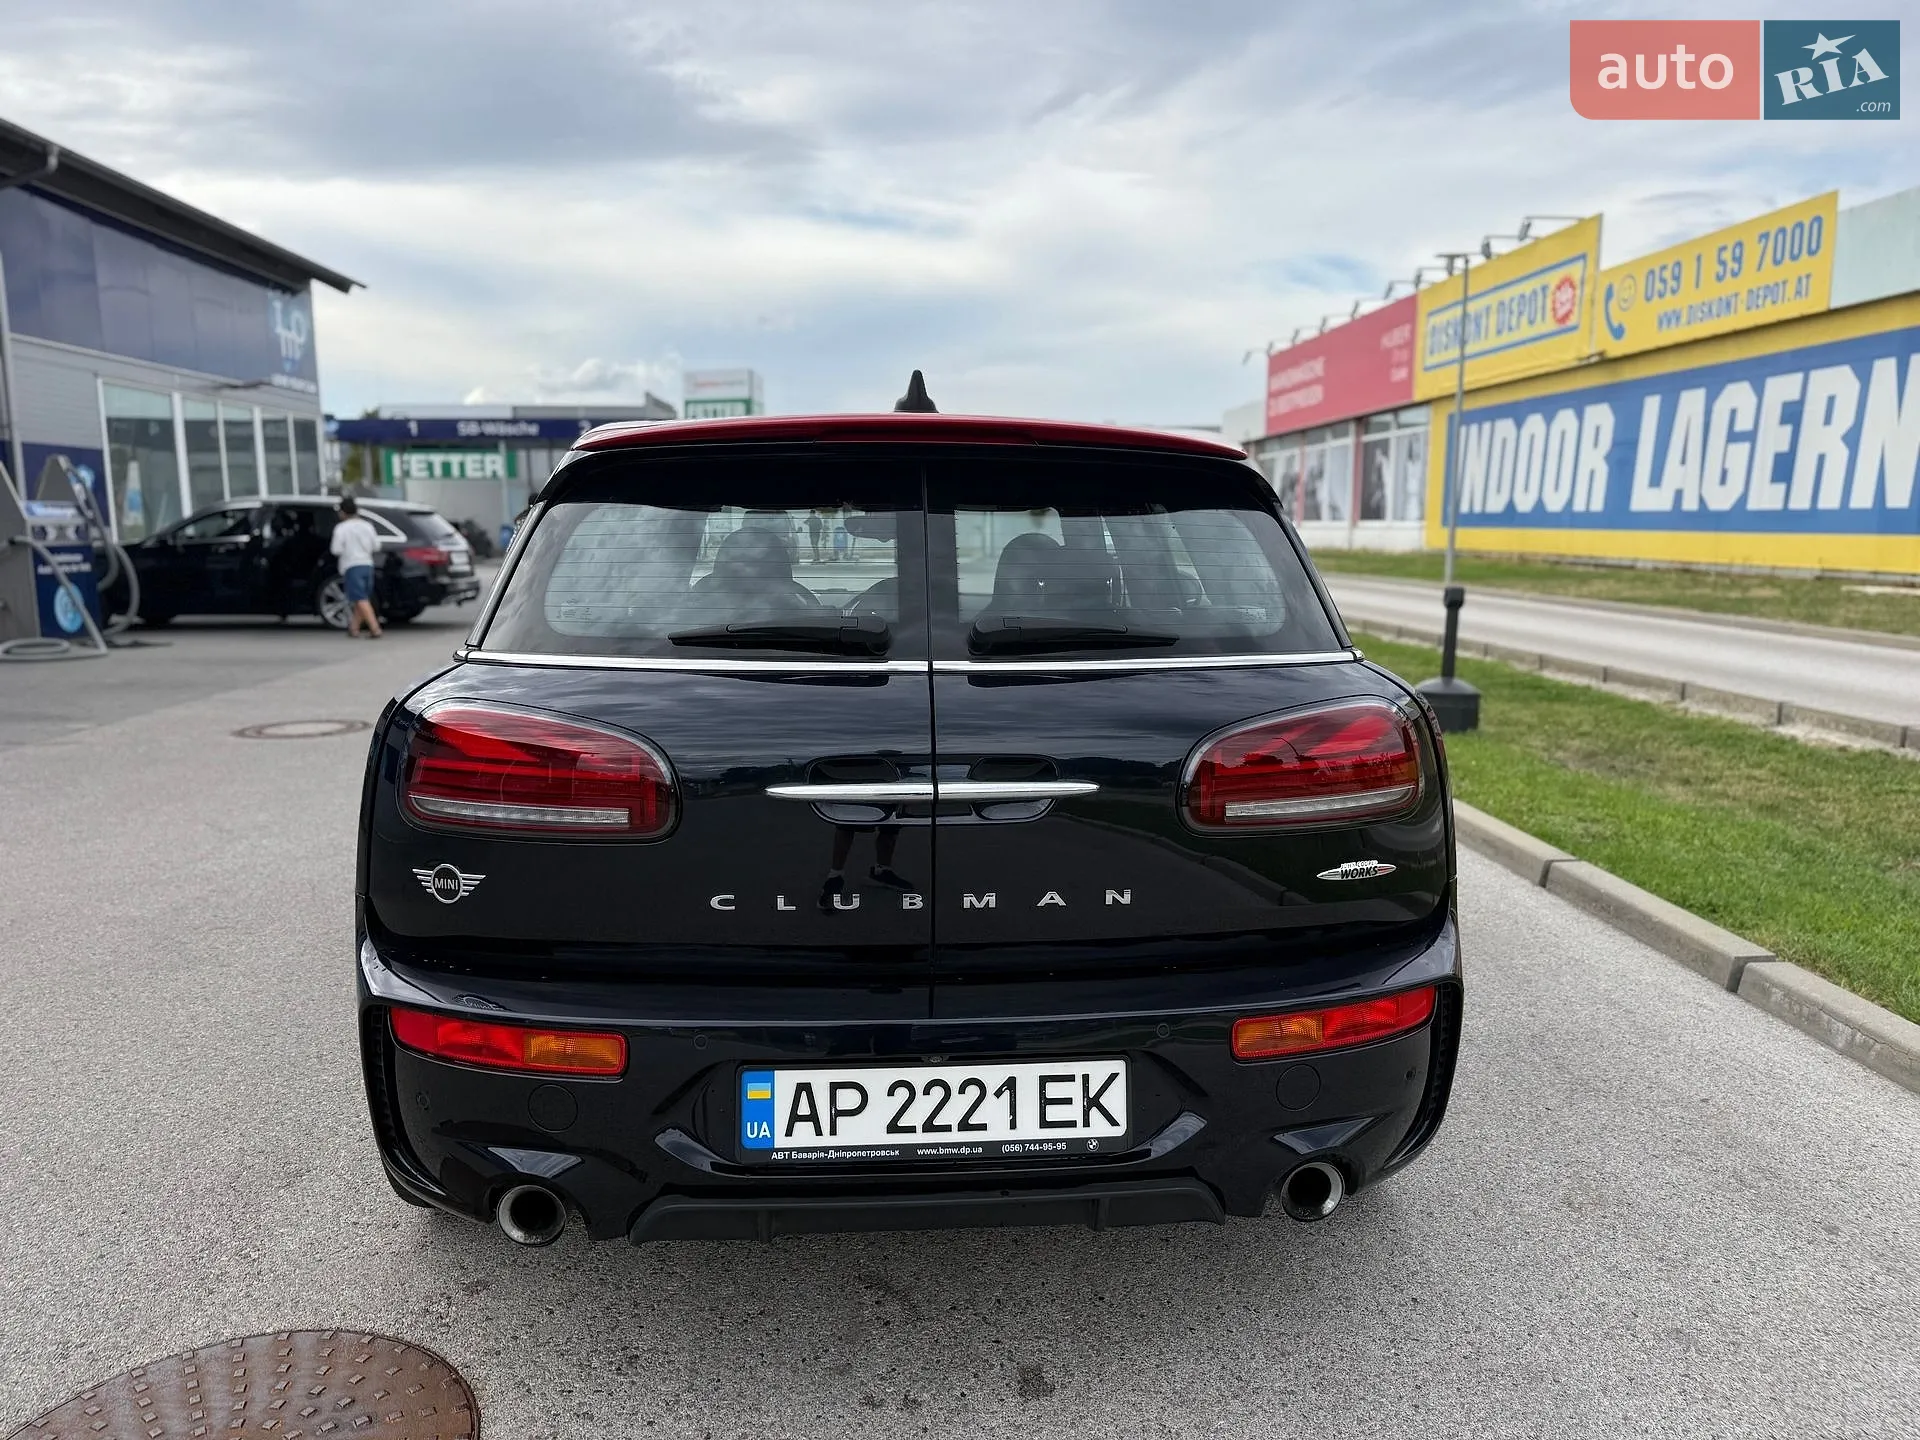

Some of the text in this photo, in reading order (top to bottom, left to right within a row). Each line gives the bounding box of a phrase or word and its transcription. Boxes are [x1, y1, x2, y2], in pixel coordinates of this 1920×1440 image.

[1644, 215, 1823, 302] 059 1 59 7000
[1496, 284, 1549, 335] DEPOT
[408, 420, 418, 437] 1
[391, 452, 504, 479] FETTER
[1341, 866, 1378, 879] WORKS
[434, 877, 459, 891] MINI
[709, 889, 1132, 911] CLUBMAN
[784, 1072, 1121, 1137] AP 2221 EK
[746, 1121, 771, 1139] UA
[916, 1142, 1068, 1156] www.bmw.dp.ua (056) 744-95-95
